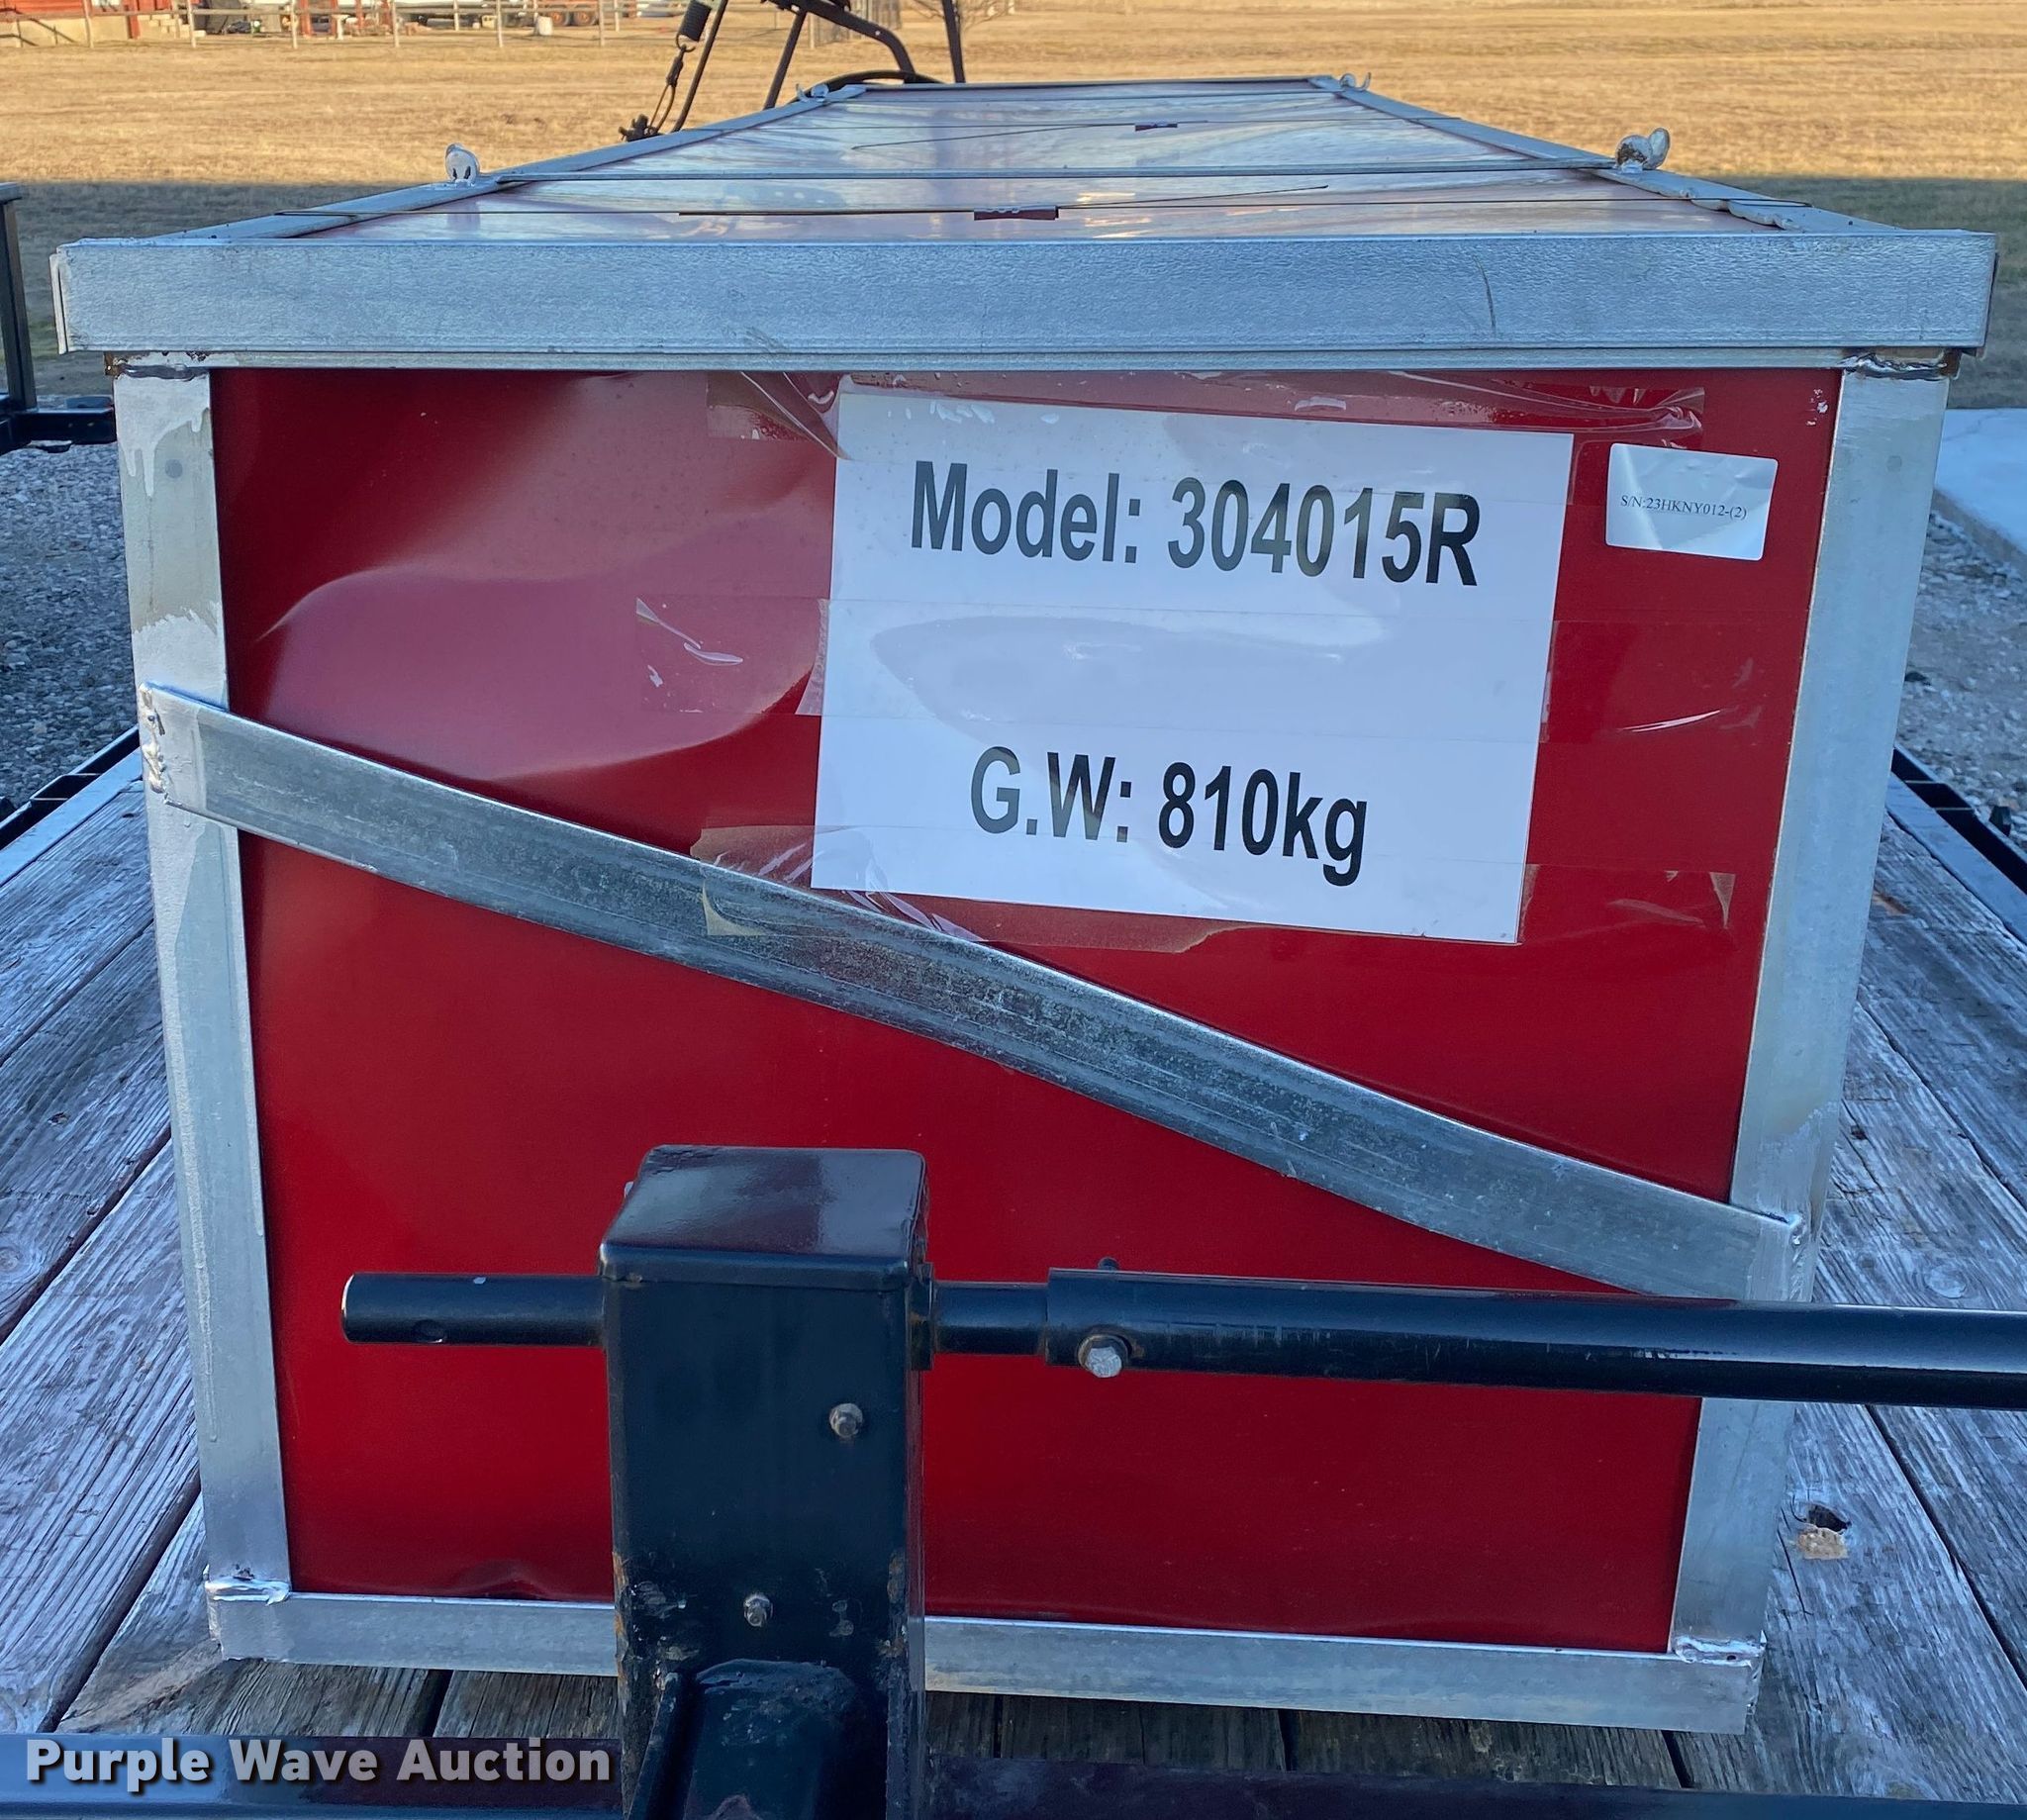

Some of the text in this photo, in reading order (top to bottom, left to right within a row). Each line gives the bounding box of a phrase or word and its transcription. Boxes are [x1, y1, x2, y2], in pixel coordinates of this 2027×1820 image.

[911, 460, 1482, 587] Model: 304015R
[970, 745, 1368, 887] G.W: 810kg
